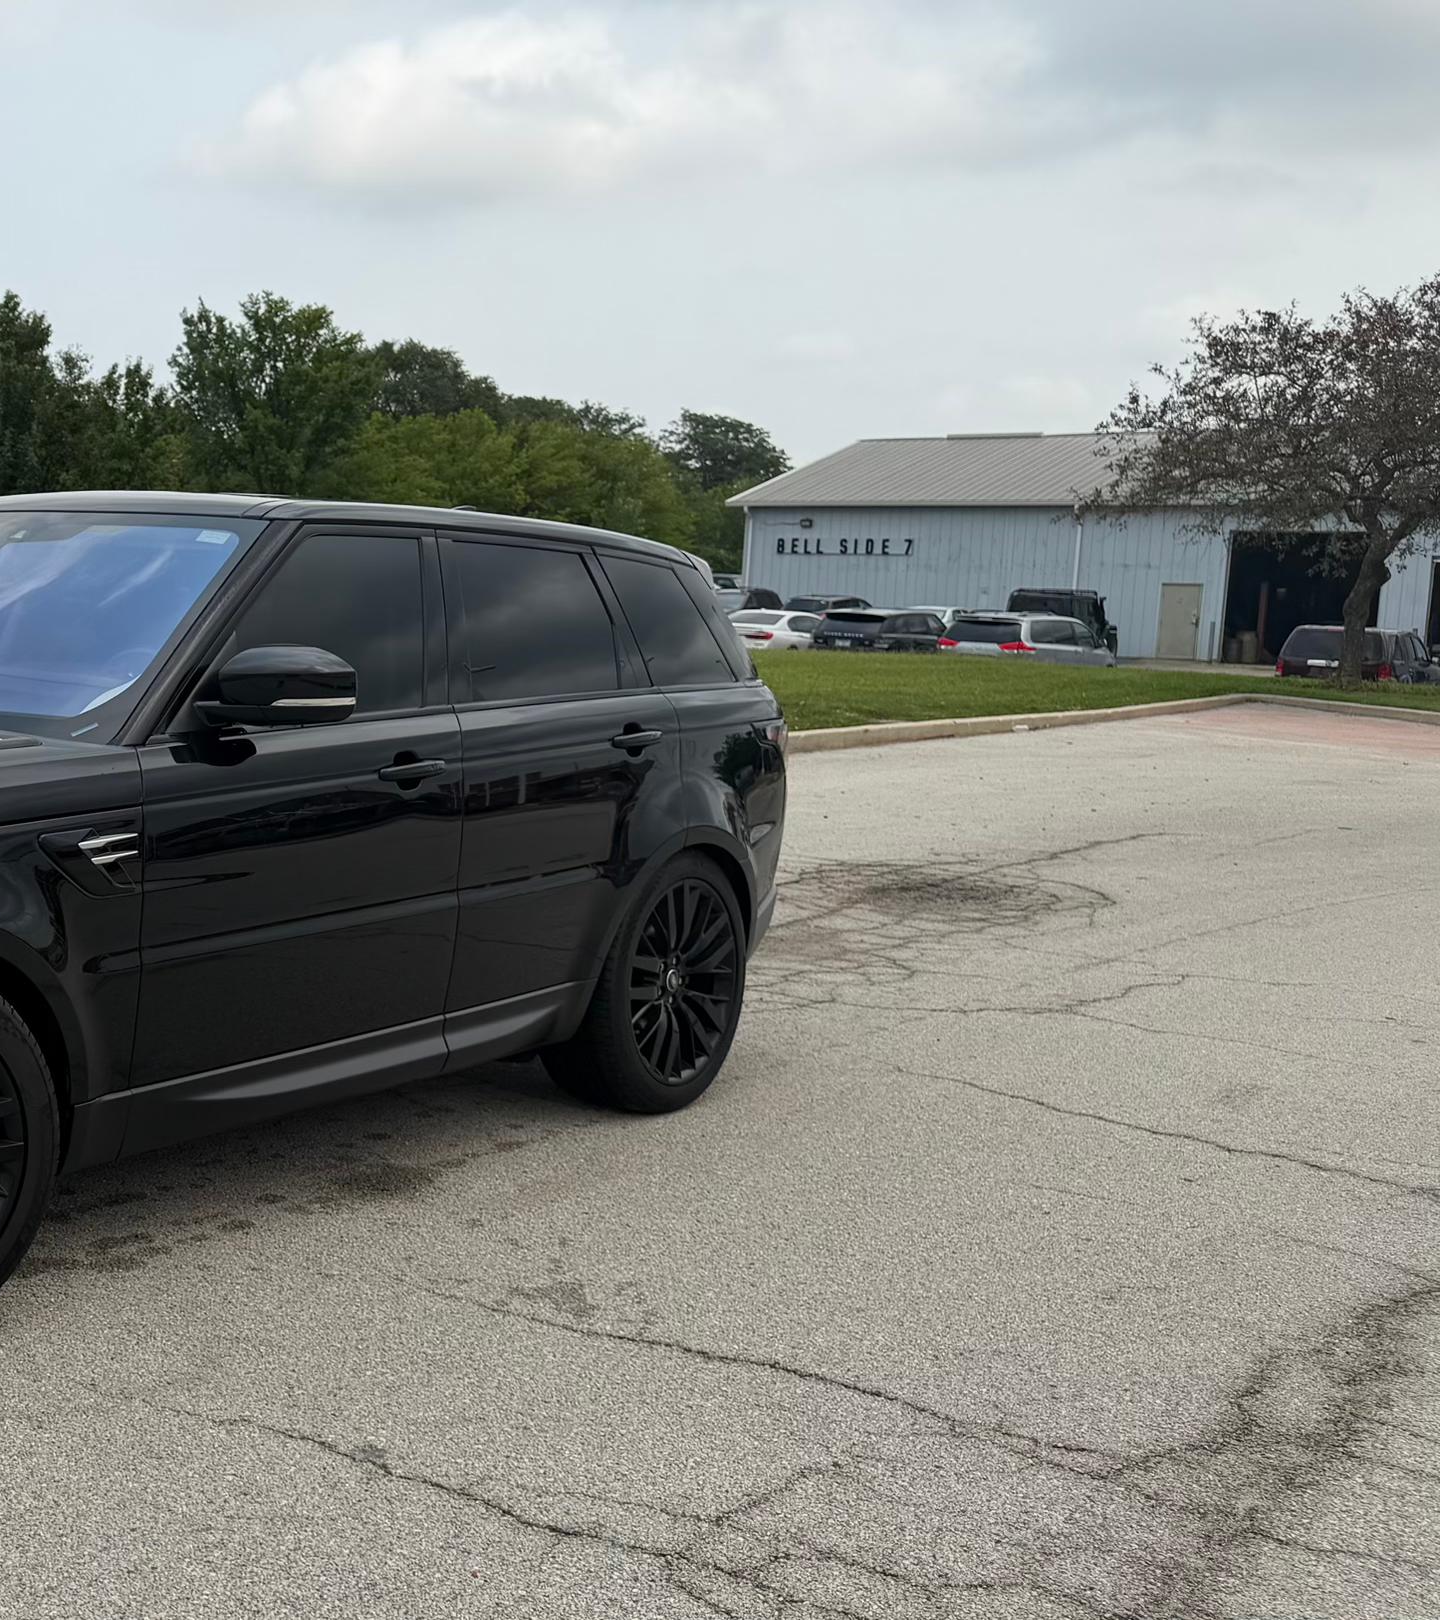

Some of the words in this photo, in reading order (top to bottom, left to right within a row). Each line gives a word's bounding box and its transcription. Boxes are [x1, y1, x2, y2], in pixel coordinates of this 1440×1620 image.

[777, 538, 823, 555] BELL
[840, 538, 890, 556] SIDE
[904, 539, 913, 556] 7
